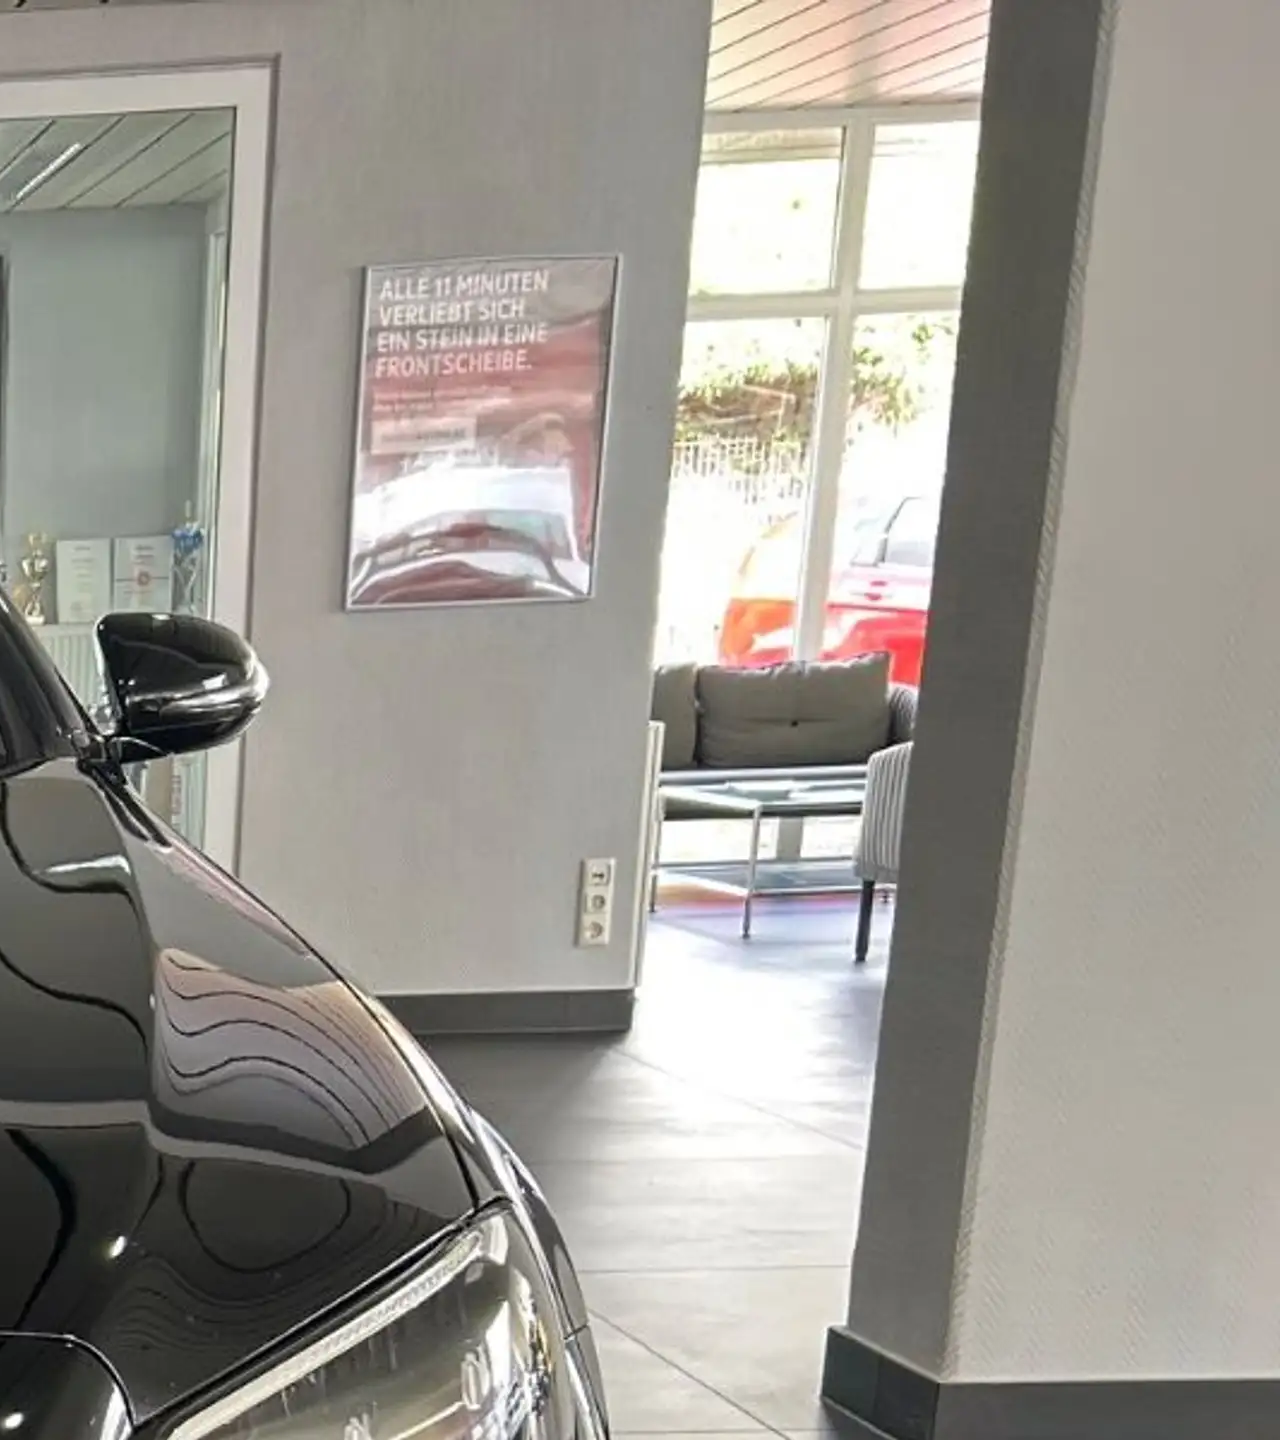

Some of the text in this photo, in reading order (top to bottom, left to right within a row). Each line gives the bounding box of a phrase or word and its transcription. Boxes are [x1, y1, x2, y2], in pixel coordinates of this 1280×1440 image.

[380, 269, 549, 300] ALLE 11 MINUTEN
[380, 297, 526, 327] VERLIEBT SICH
[377, 321, 548, 352] EIN STEIN IN EINE
[374, 348, 533, 379] FRONTSCHEIBE.
